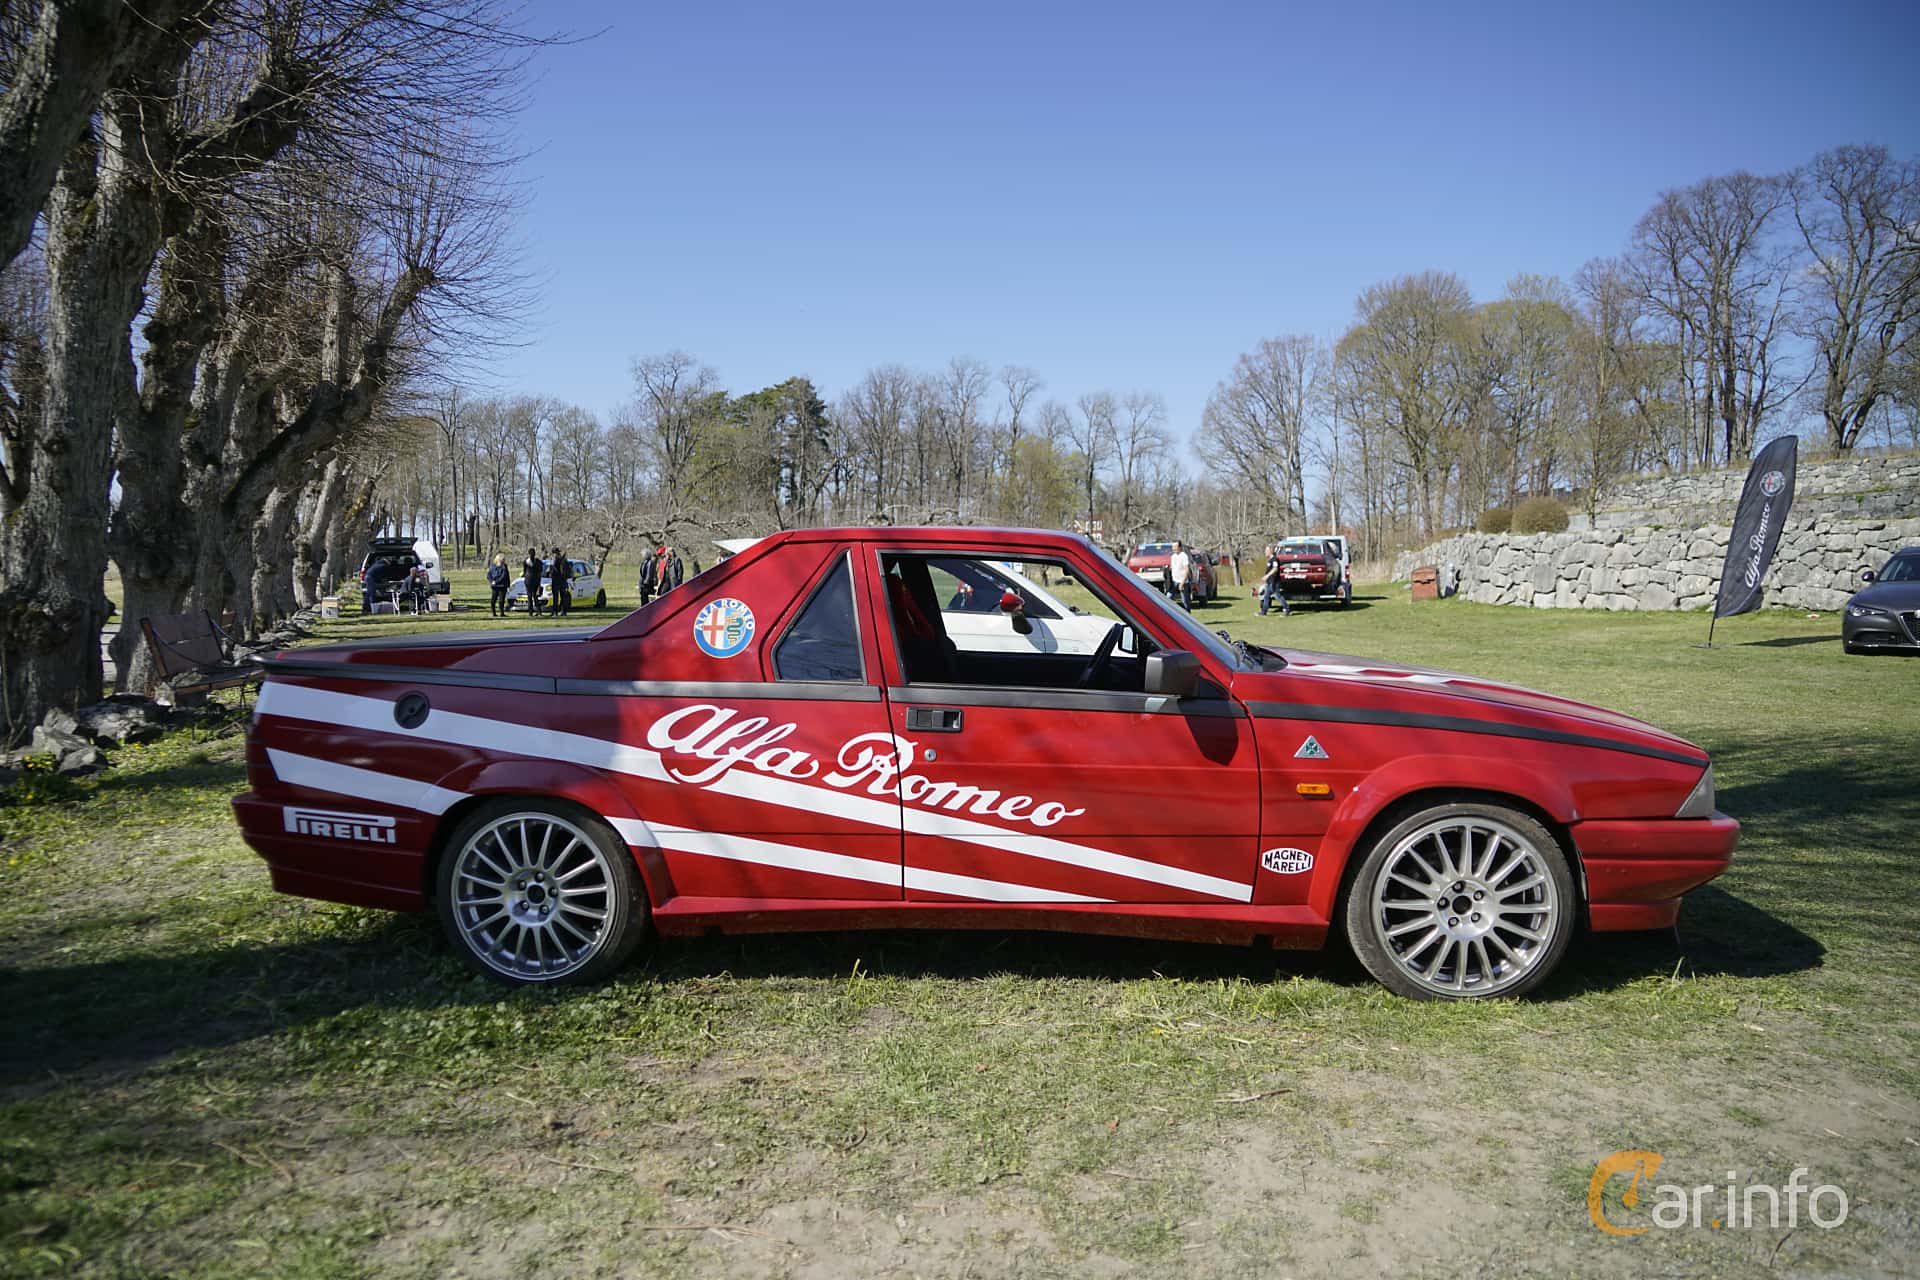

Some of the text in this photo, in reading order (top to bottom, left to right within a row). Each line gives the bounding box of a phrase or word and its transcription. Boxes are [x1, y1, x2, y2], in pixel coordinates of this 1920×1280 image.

[1745, 551, 1761, 588] Alfa
[695, 599, 754, 631] ALFA ROMEO
[647, 704, 1086, 827] Alfa Romeo
[283, 806, 396, 843] PIRELLI
[1264, 849, 1311, 866] MAGNETI
